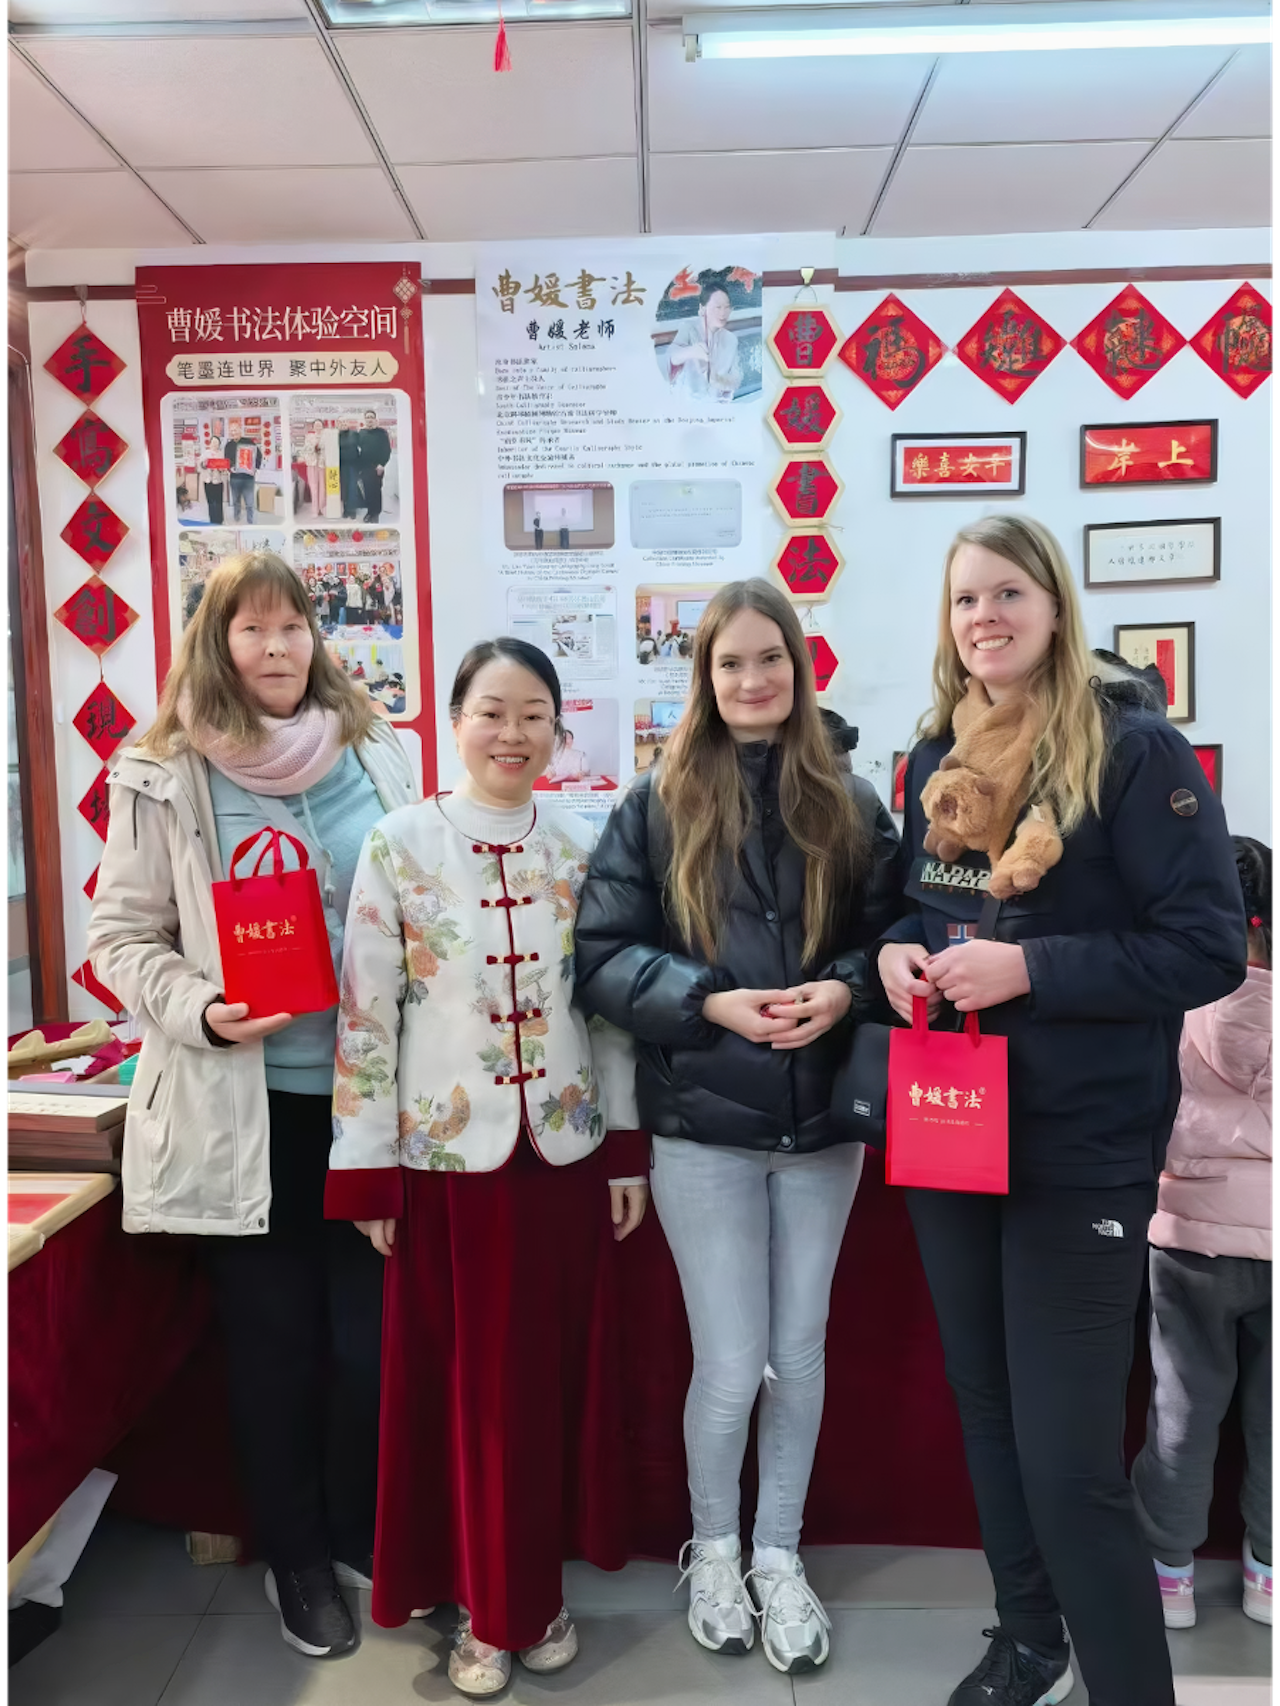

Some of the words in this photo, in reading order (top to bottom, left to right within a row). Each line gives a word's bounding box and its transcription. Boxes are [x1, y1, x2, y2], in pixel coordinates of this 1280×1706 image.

[492, 268, 647, 314] 曹媛書法
[165, 305, 398, 343] 曹媛书法体验空间
[525, 318, 616, 341] 曹媛老师
[176, 359, 275, 380] 笔墨连世界
[289, 358, 388, 378] 聚中外友人
[233, 918, 295, 944] 曹媛書法
[908, 1080, 983, 1110] 曹媛書法
